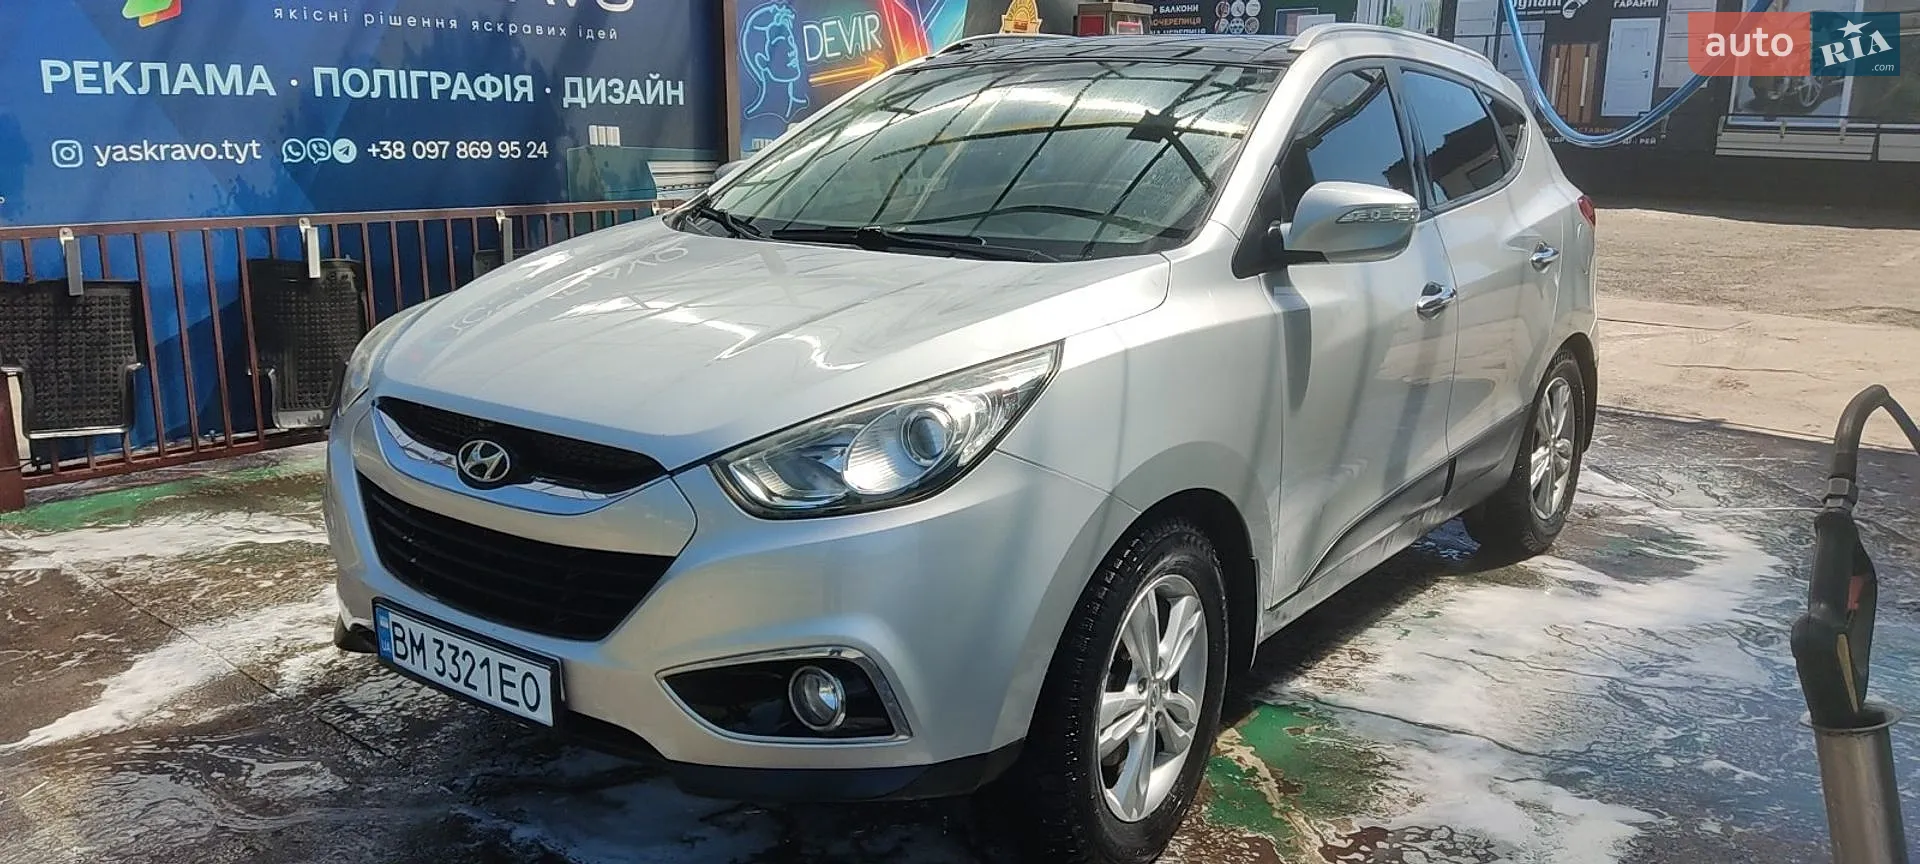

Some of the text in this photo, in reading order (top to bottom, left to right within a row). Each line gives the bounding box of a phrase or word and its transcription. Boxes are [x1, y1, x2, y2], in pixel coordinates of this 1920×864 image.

[273, 7, 618, 40] якісні рішення яскравих ідей
[1152, 17, 1202, 26] ОЧЕРЕПИЦЯ
[1159, 4, 1199, 13] БАЛКОНИ
[802, 13, 883, 62] DEVIR
[40, 59, 685, 109] РЕКЛАМА ПОЛІГРАФІЯ ДИЗАЙН
[93, 139, 549, 168] yaskravo.tyt +38 097 869 95 24
[432, 638, 493, 697] 3321
